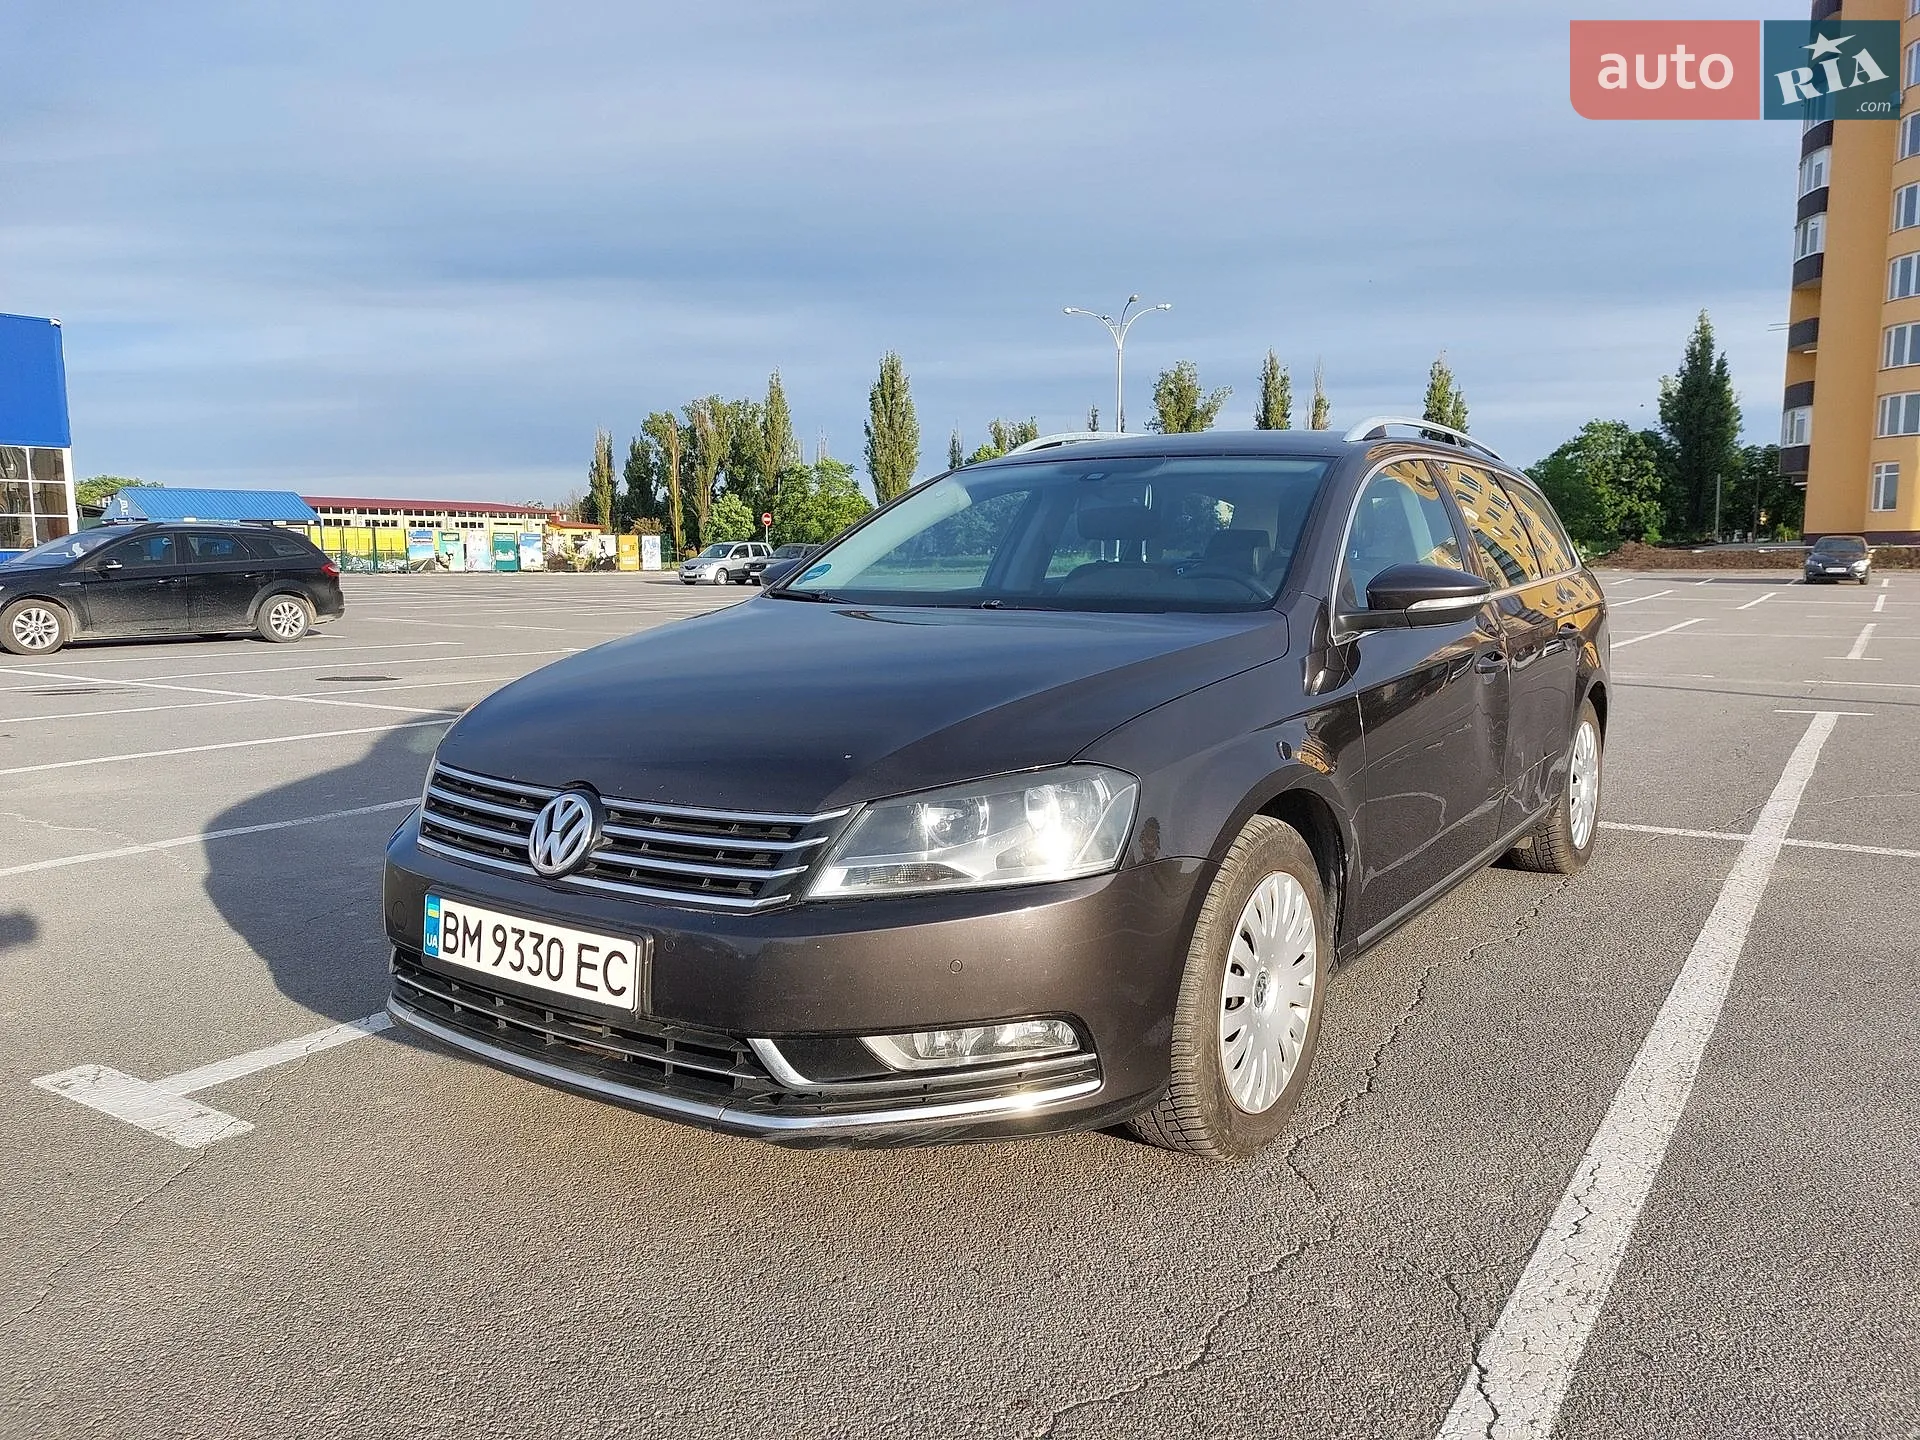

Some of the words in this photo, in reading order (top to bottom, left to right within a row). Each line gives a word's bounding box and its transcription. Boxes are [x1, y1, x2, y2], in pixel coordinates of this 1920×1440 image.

[426, 933, 439, 949] UA
[442, 910, 483, 963] BM
[491, 923, 564, 982] 9330
[575, 942, 628, 997] EC
